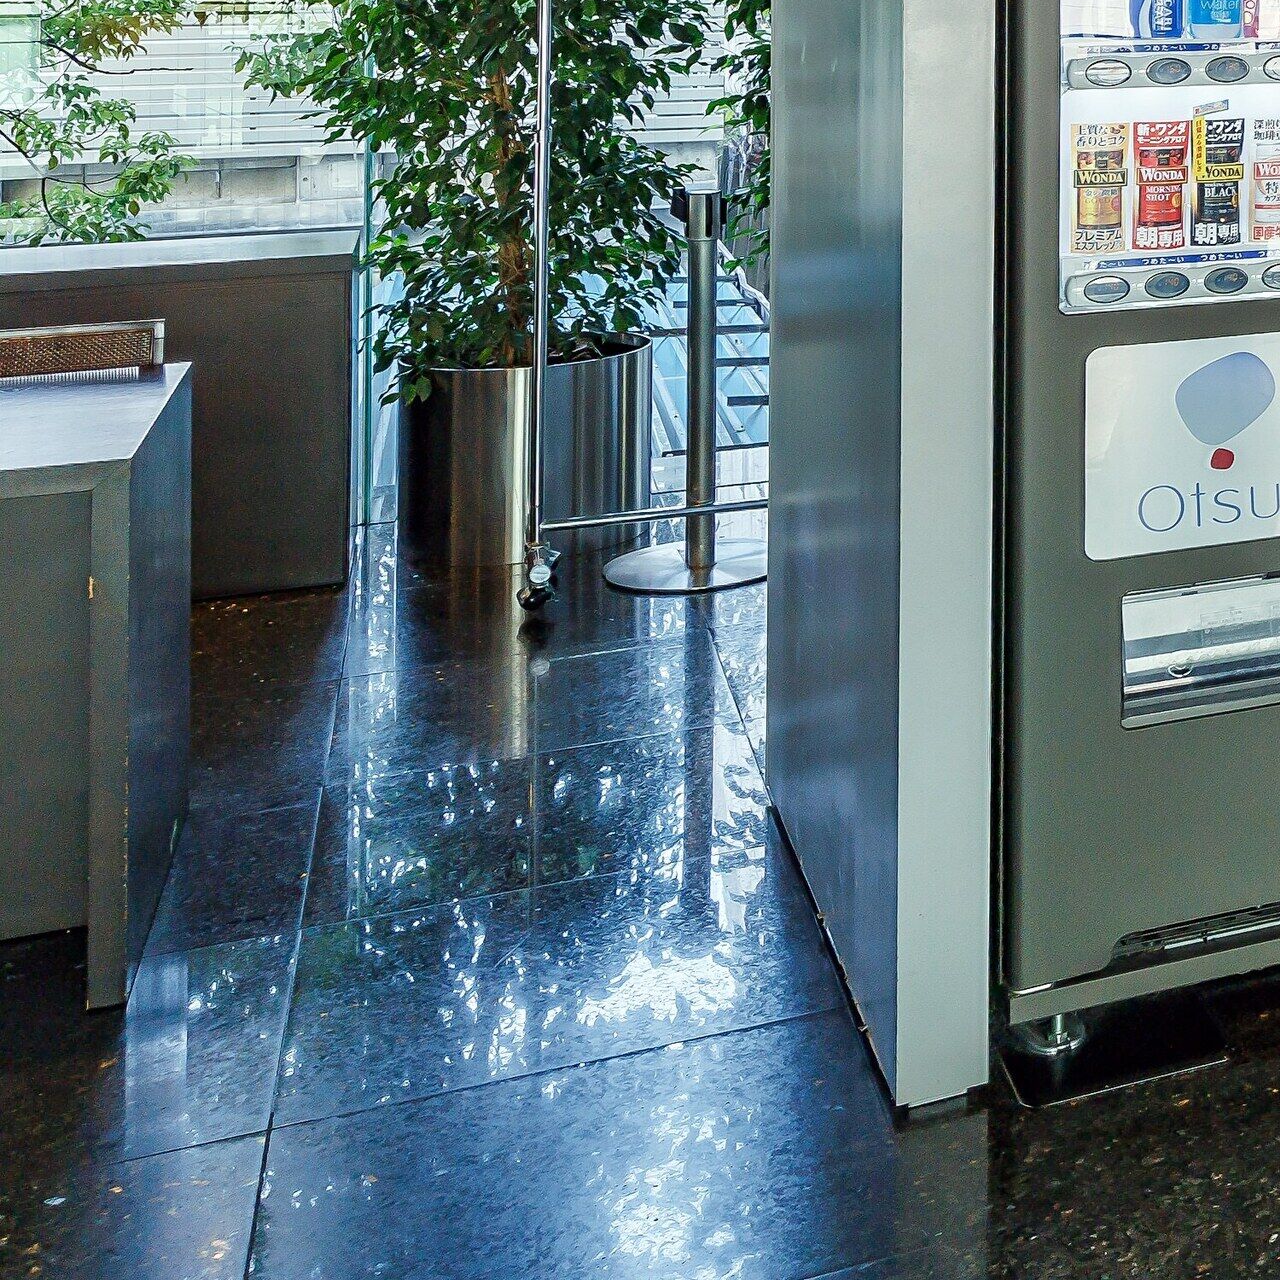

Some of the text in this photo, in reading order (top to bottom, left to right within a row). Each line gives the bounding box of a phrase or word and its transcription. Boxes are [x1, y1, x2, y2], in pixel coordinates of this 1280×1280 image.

[1200, 0, 1241, 11] water
[1076, 135, 1125, 147] 香りとコク
[1077, 170, 1124, 185] WONDA
[1140, 168, 1184, 182] WONDA
[1146, 193, 1171, 202] SHOT
[1075, 229, 1122, 241] プレミアム
